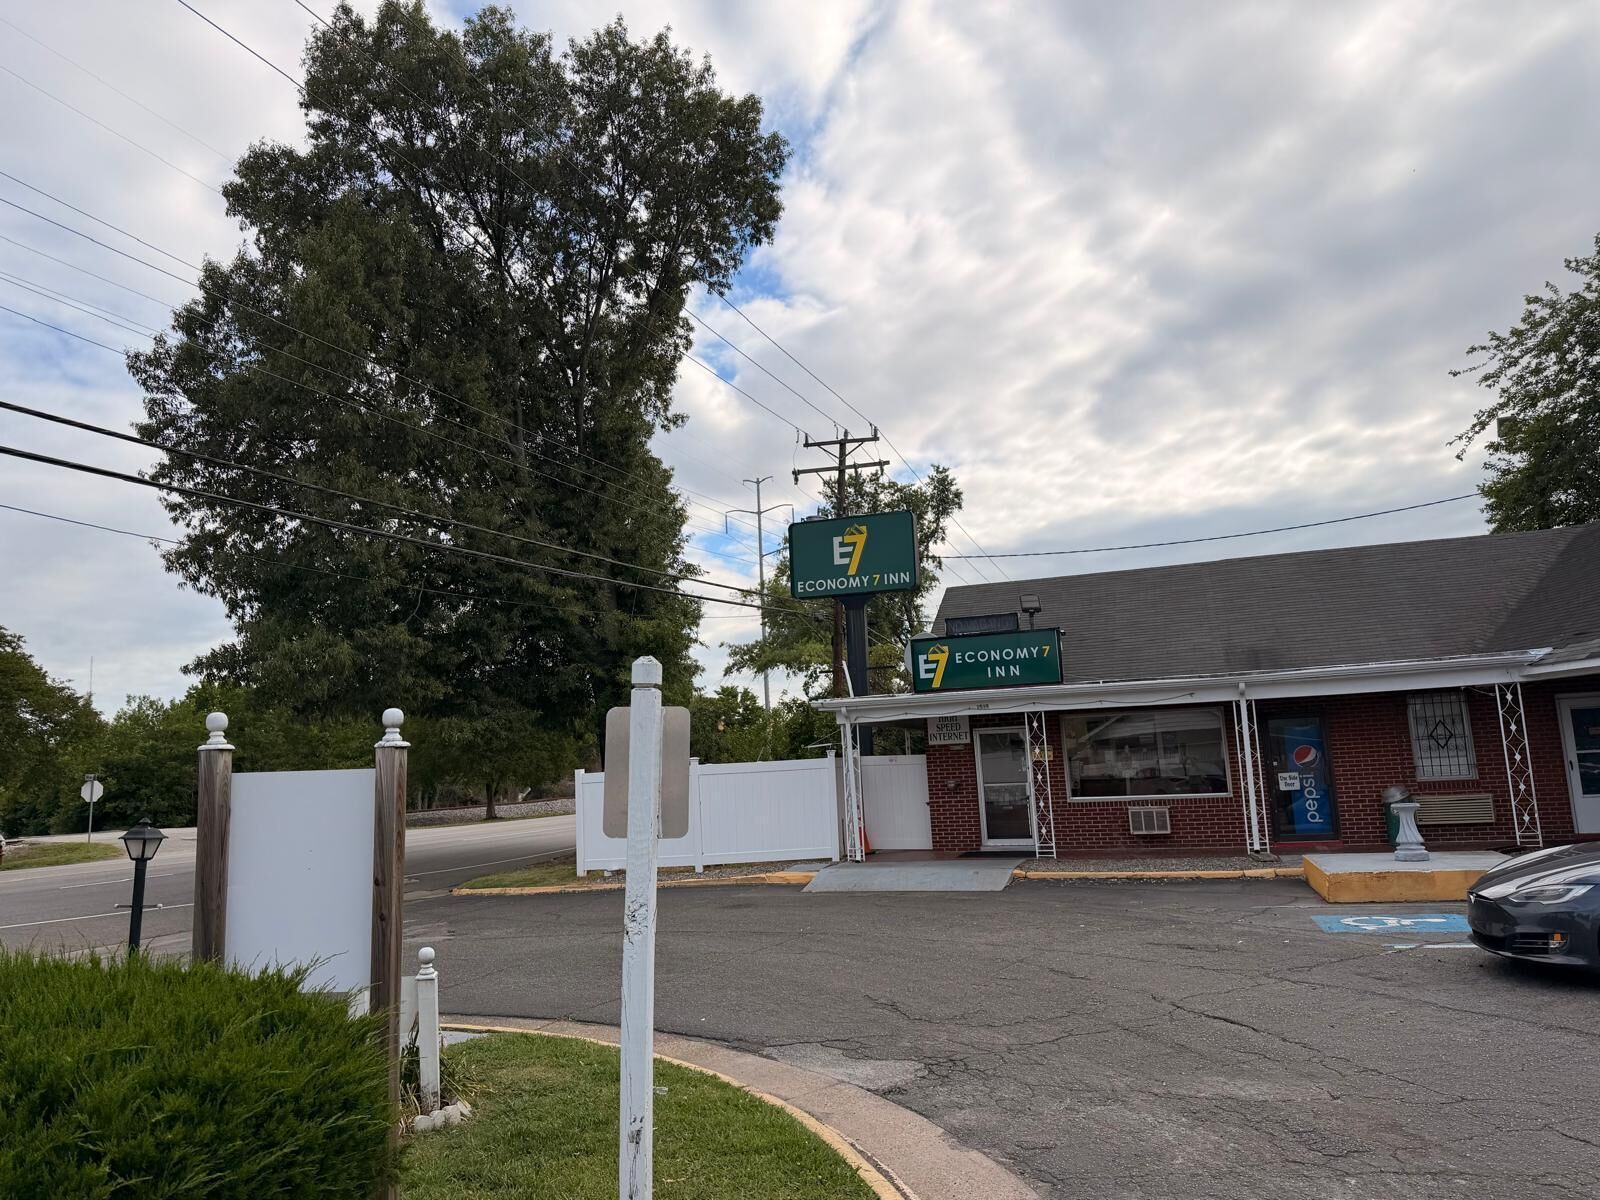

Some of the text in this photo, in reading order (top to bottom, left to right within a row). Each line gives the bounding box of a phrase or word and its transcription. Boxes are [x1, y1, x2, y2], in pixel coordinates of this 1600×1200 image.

[833, 524, 868, 576] E7
[797, 571, 910, 593] ECONOMY 7 INN
[918, 644, 949, 688] E7
[955, 645, 1051, 678] ECONOMY 7 INN
[929, 731, 969, 742] INTERNET
[936, 722, 961, 732] SPEED
[1301, 774, 1324, 823] pepsi
